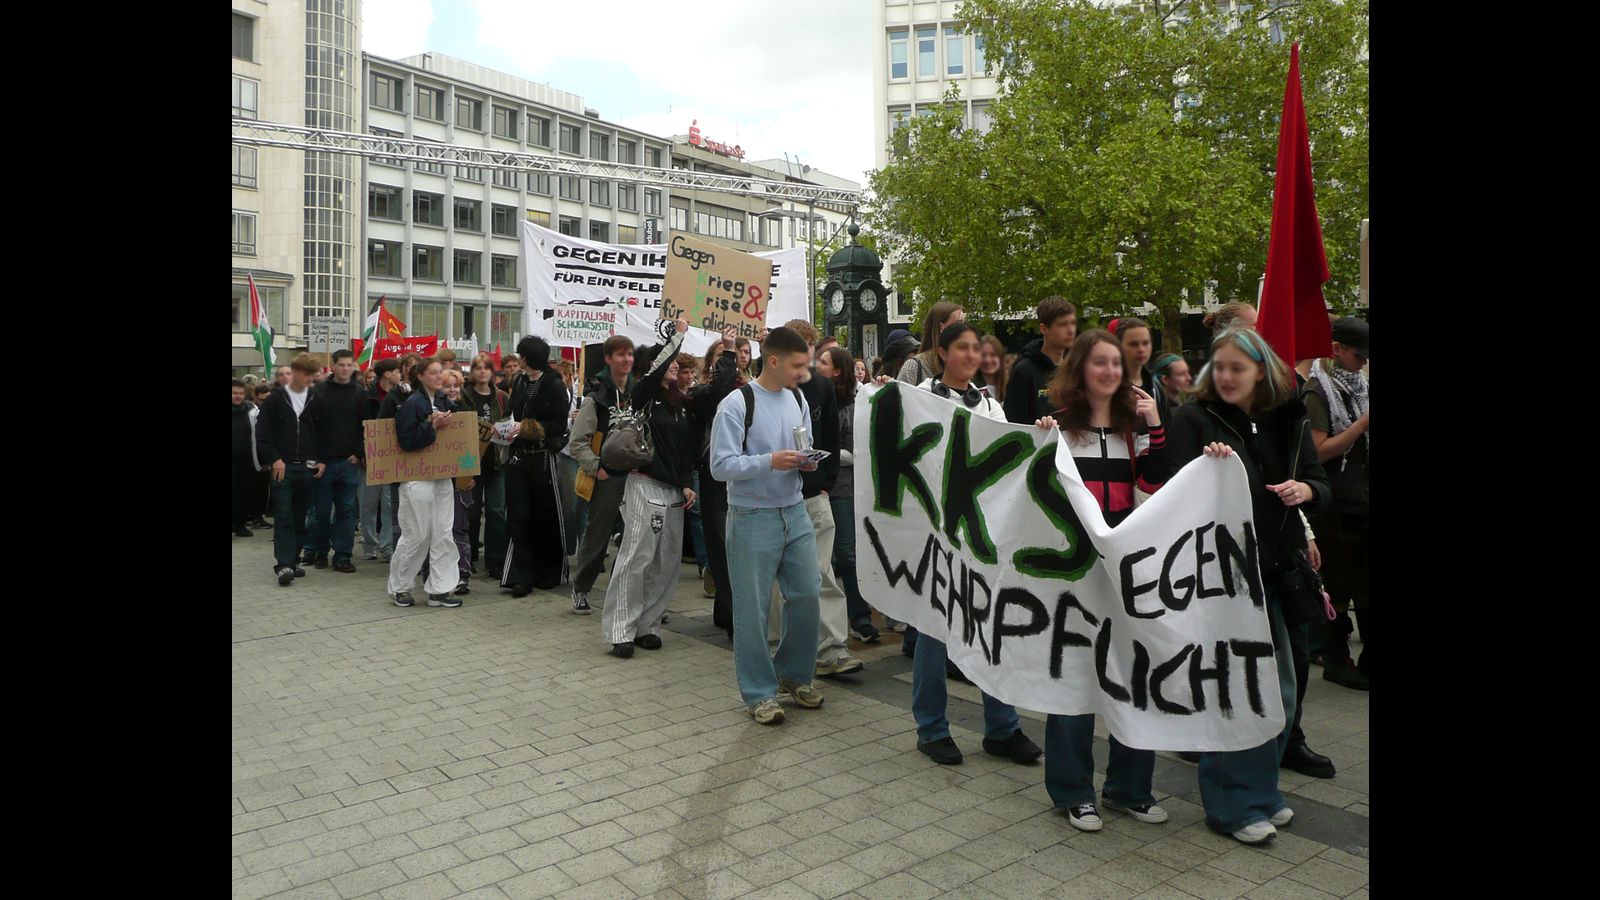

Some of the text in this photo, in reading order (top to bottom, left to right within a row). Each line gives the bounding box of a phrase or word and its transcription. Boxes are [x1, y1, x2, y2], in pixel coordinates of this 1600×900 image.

[552, 245, 666, 268] GEGEN IH
[671, 235, 716, 271] Gegen
[554, 272, 664, 293] FÜR EIN SELB
[643, 298, 662, 309] LE
[662, 298, 685, 320] für
[743, 285, 765, 321] &
[557, 329, 601, 340] VIETKONG
[869, 380, 1265, 620] KKS EGEN
[863, 515, 1275, 719] WEHRPFLICHT
